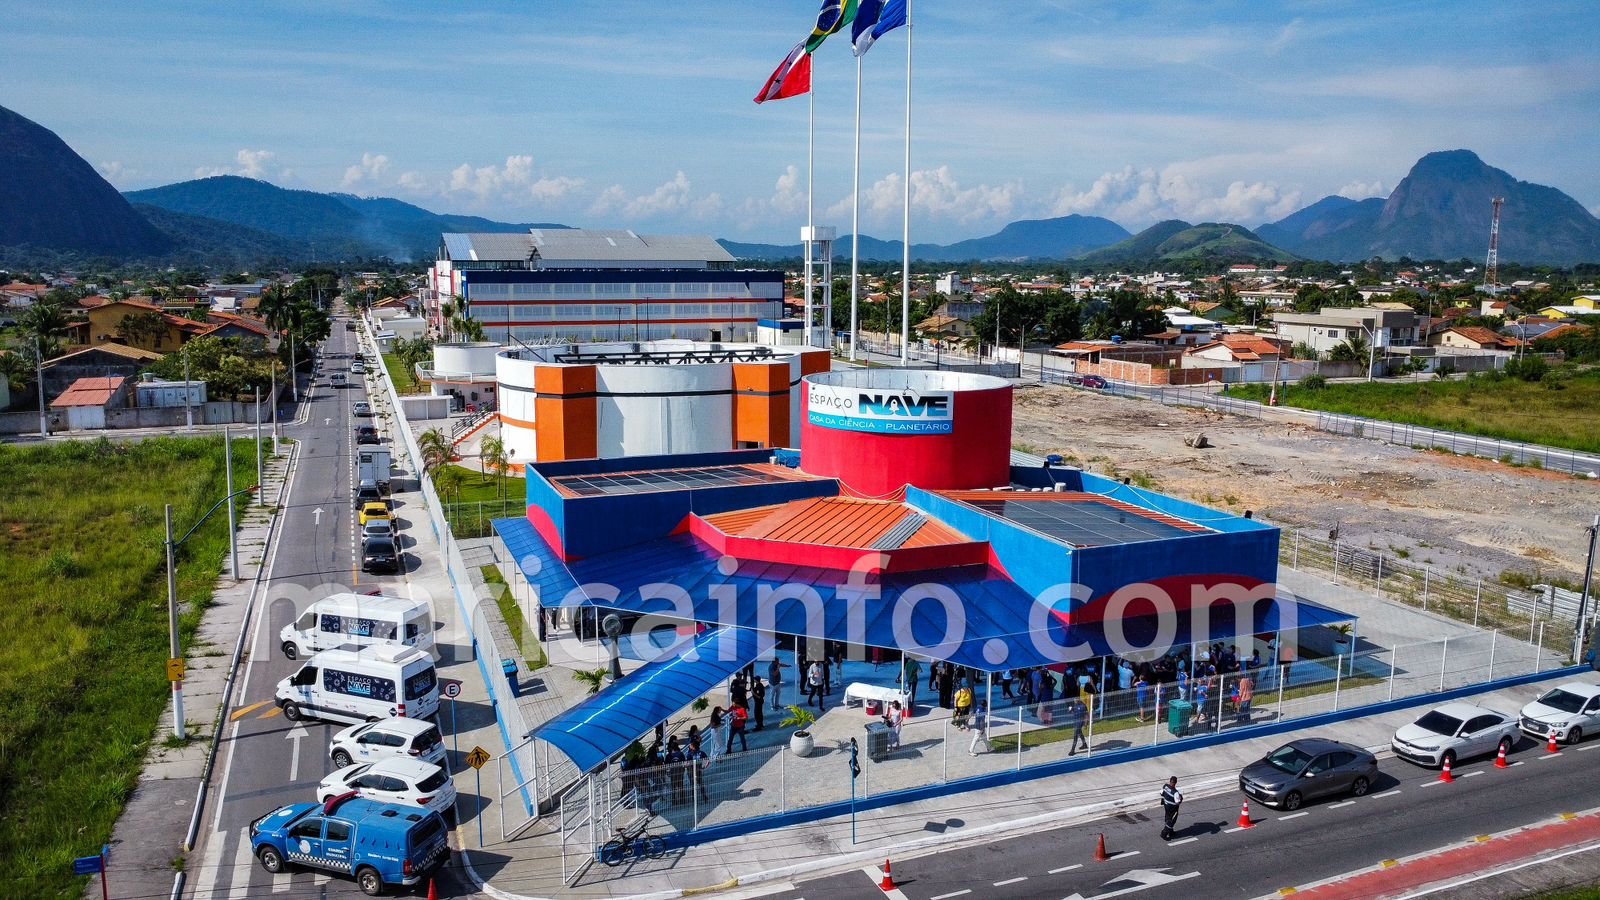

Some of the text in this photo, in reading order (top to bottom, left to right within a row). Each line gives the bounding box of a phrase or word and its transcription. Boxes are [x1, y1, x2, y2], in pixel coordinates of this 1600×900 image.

[810, 393, 852, 409] ESPAÇO
[859, 393, 948, 416] NAVE
[810, 414, 824, 423] CASA
[825, 417, 836, 425] DA
[838, 418, 876, 429] CIÊNCIA
[885, 422, 950, 431] PLANETÁRIO
[347, 675, 372, 684] ESPAÇO
[347, 680, 371, 695] NAVE
[449, 685, 456, 695] E
